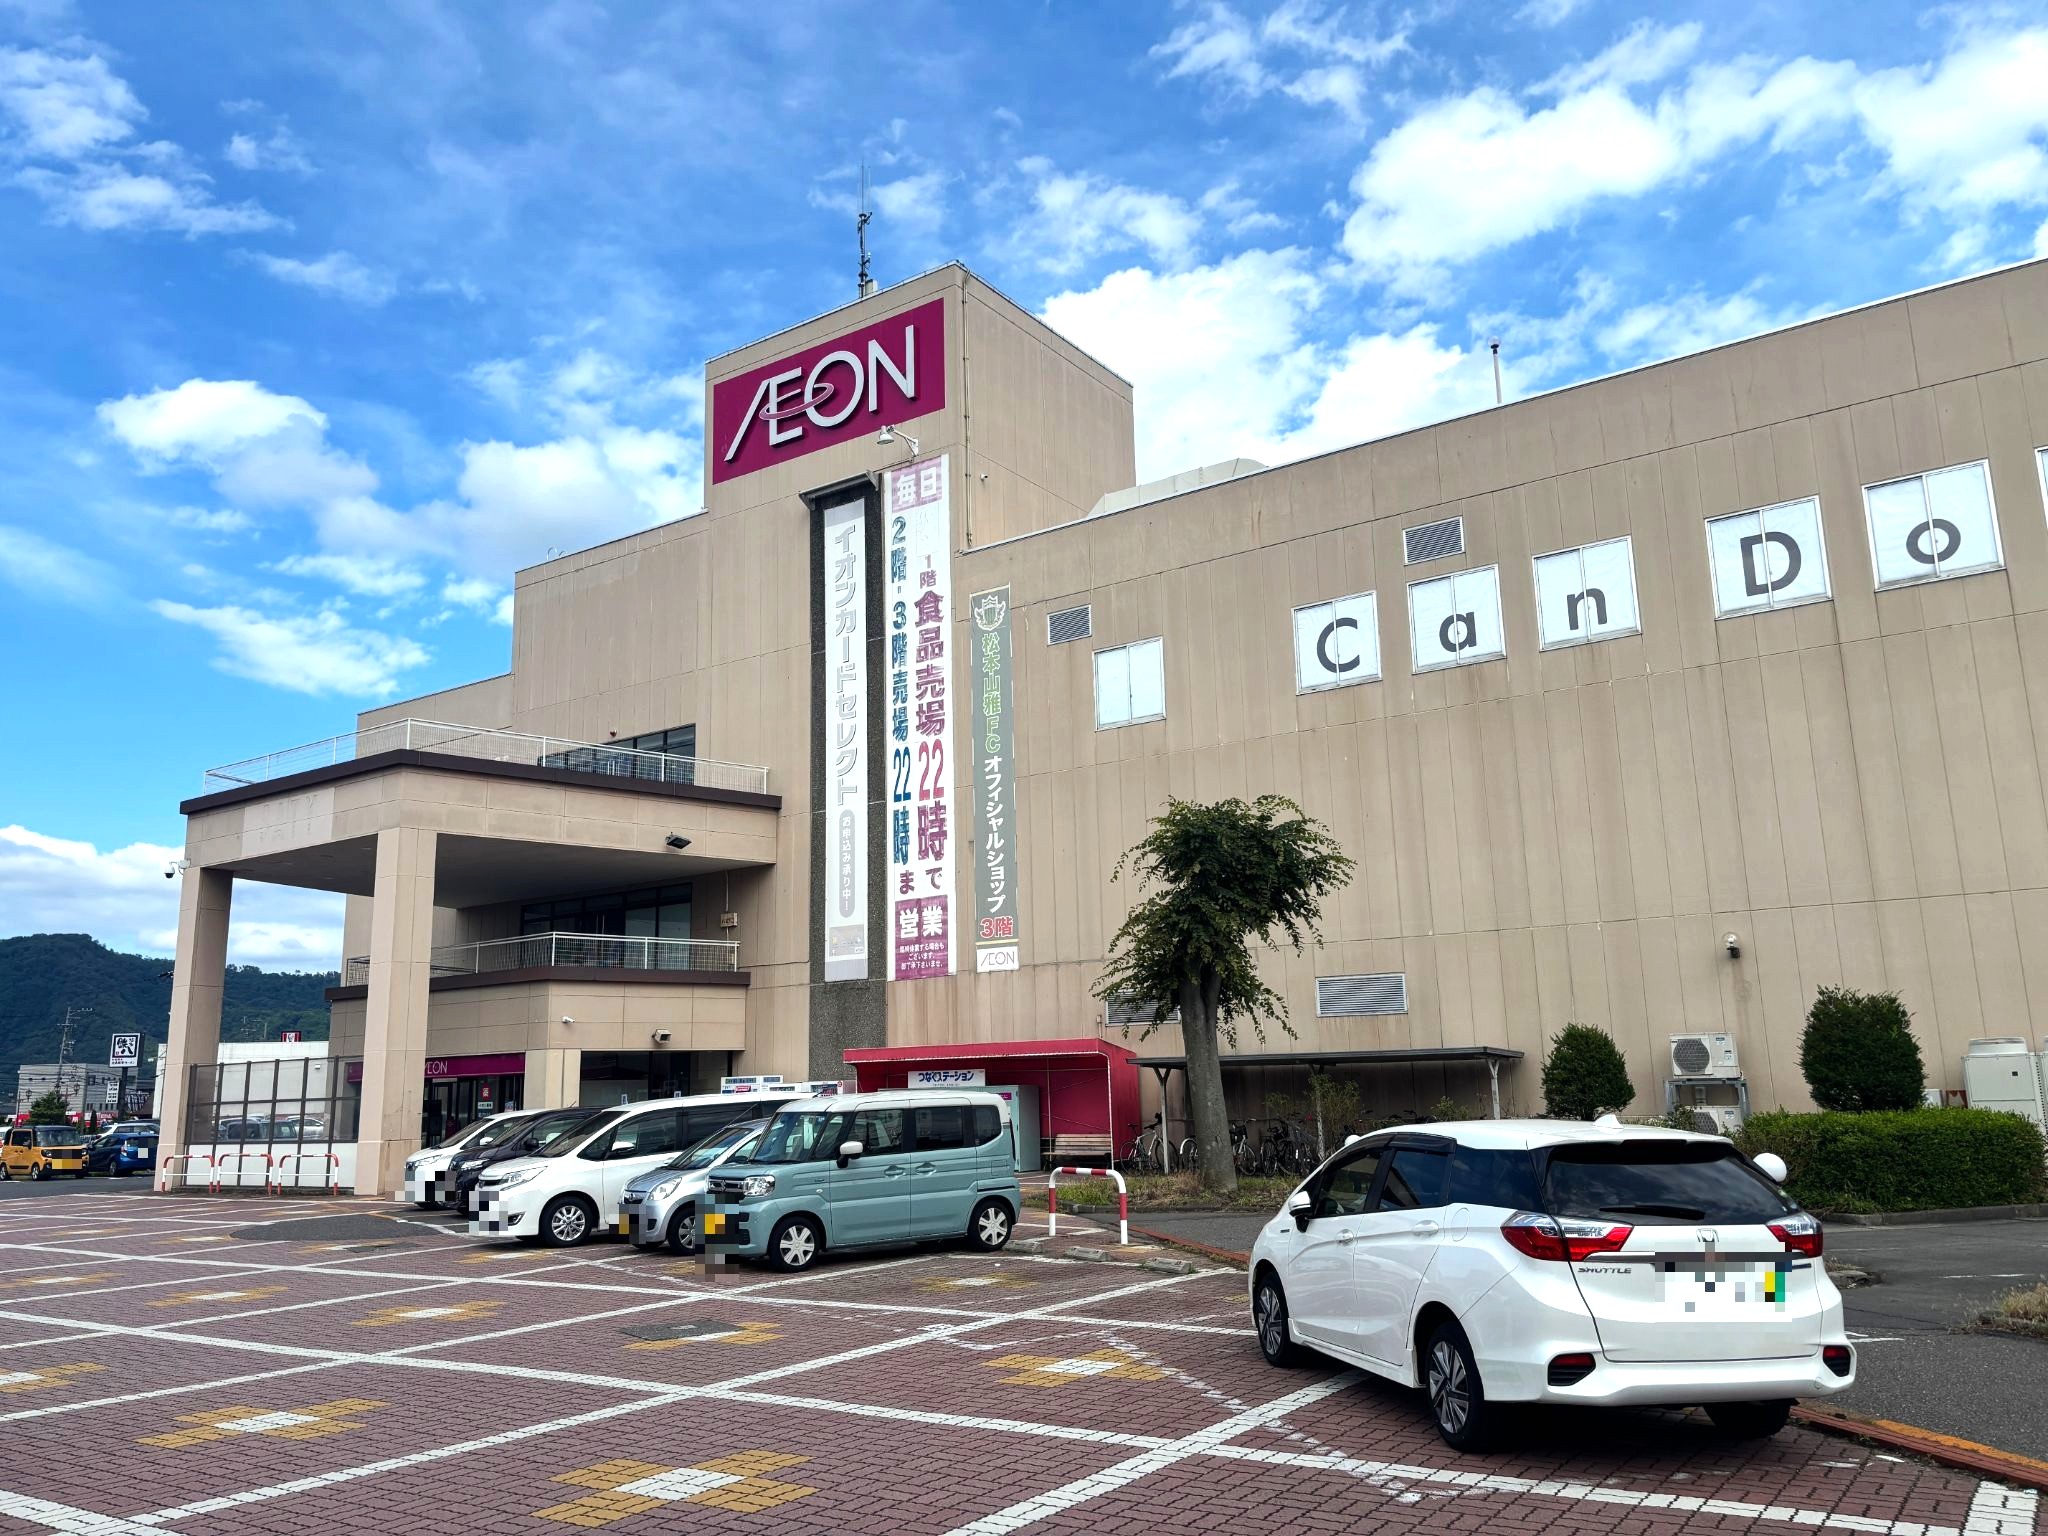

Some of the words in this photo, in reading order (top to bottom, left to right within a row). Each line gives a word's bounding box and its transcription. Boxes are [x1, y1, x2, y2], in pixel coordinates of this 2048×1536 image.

[896, 466, 937, 505] 毎日
[834, 523, 858, 807] イオンカードセレクト
[899, 903, 944, 939] 営業
[979, 915, 1014, 939] 3階
